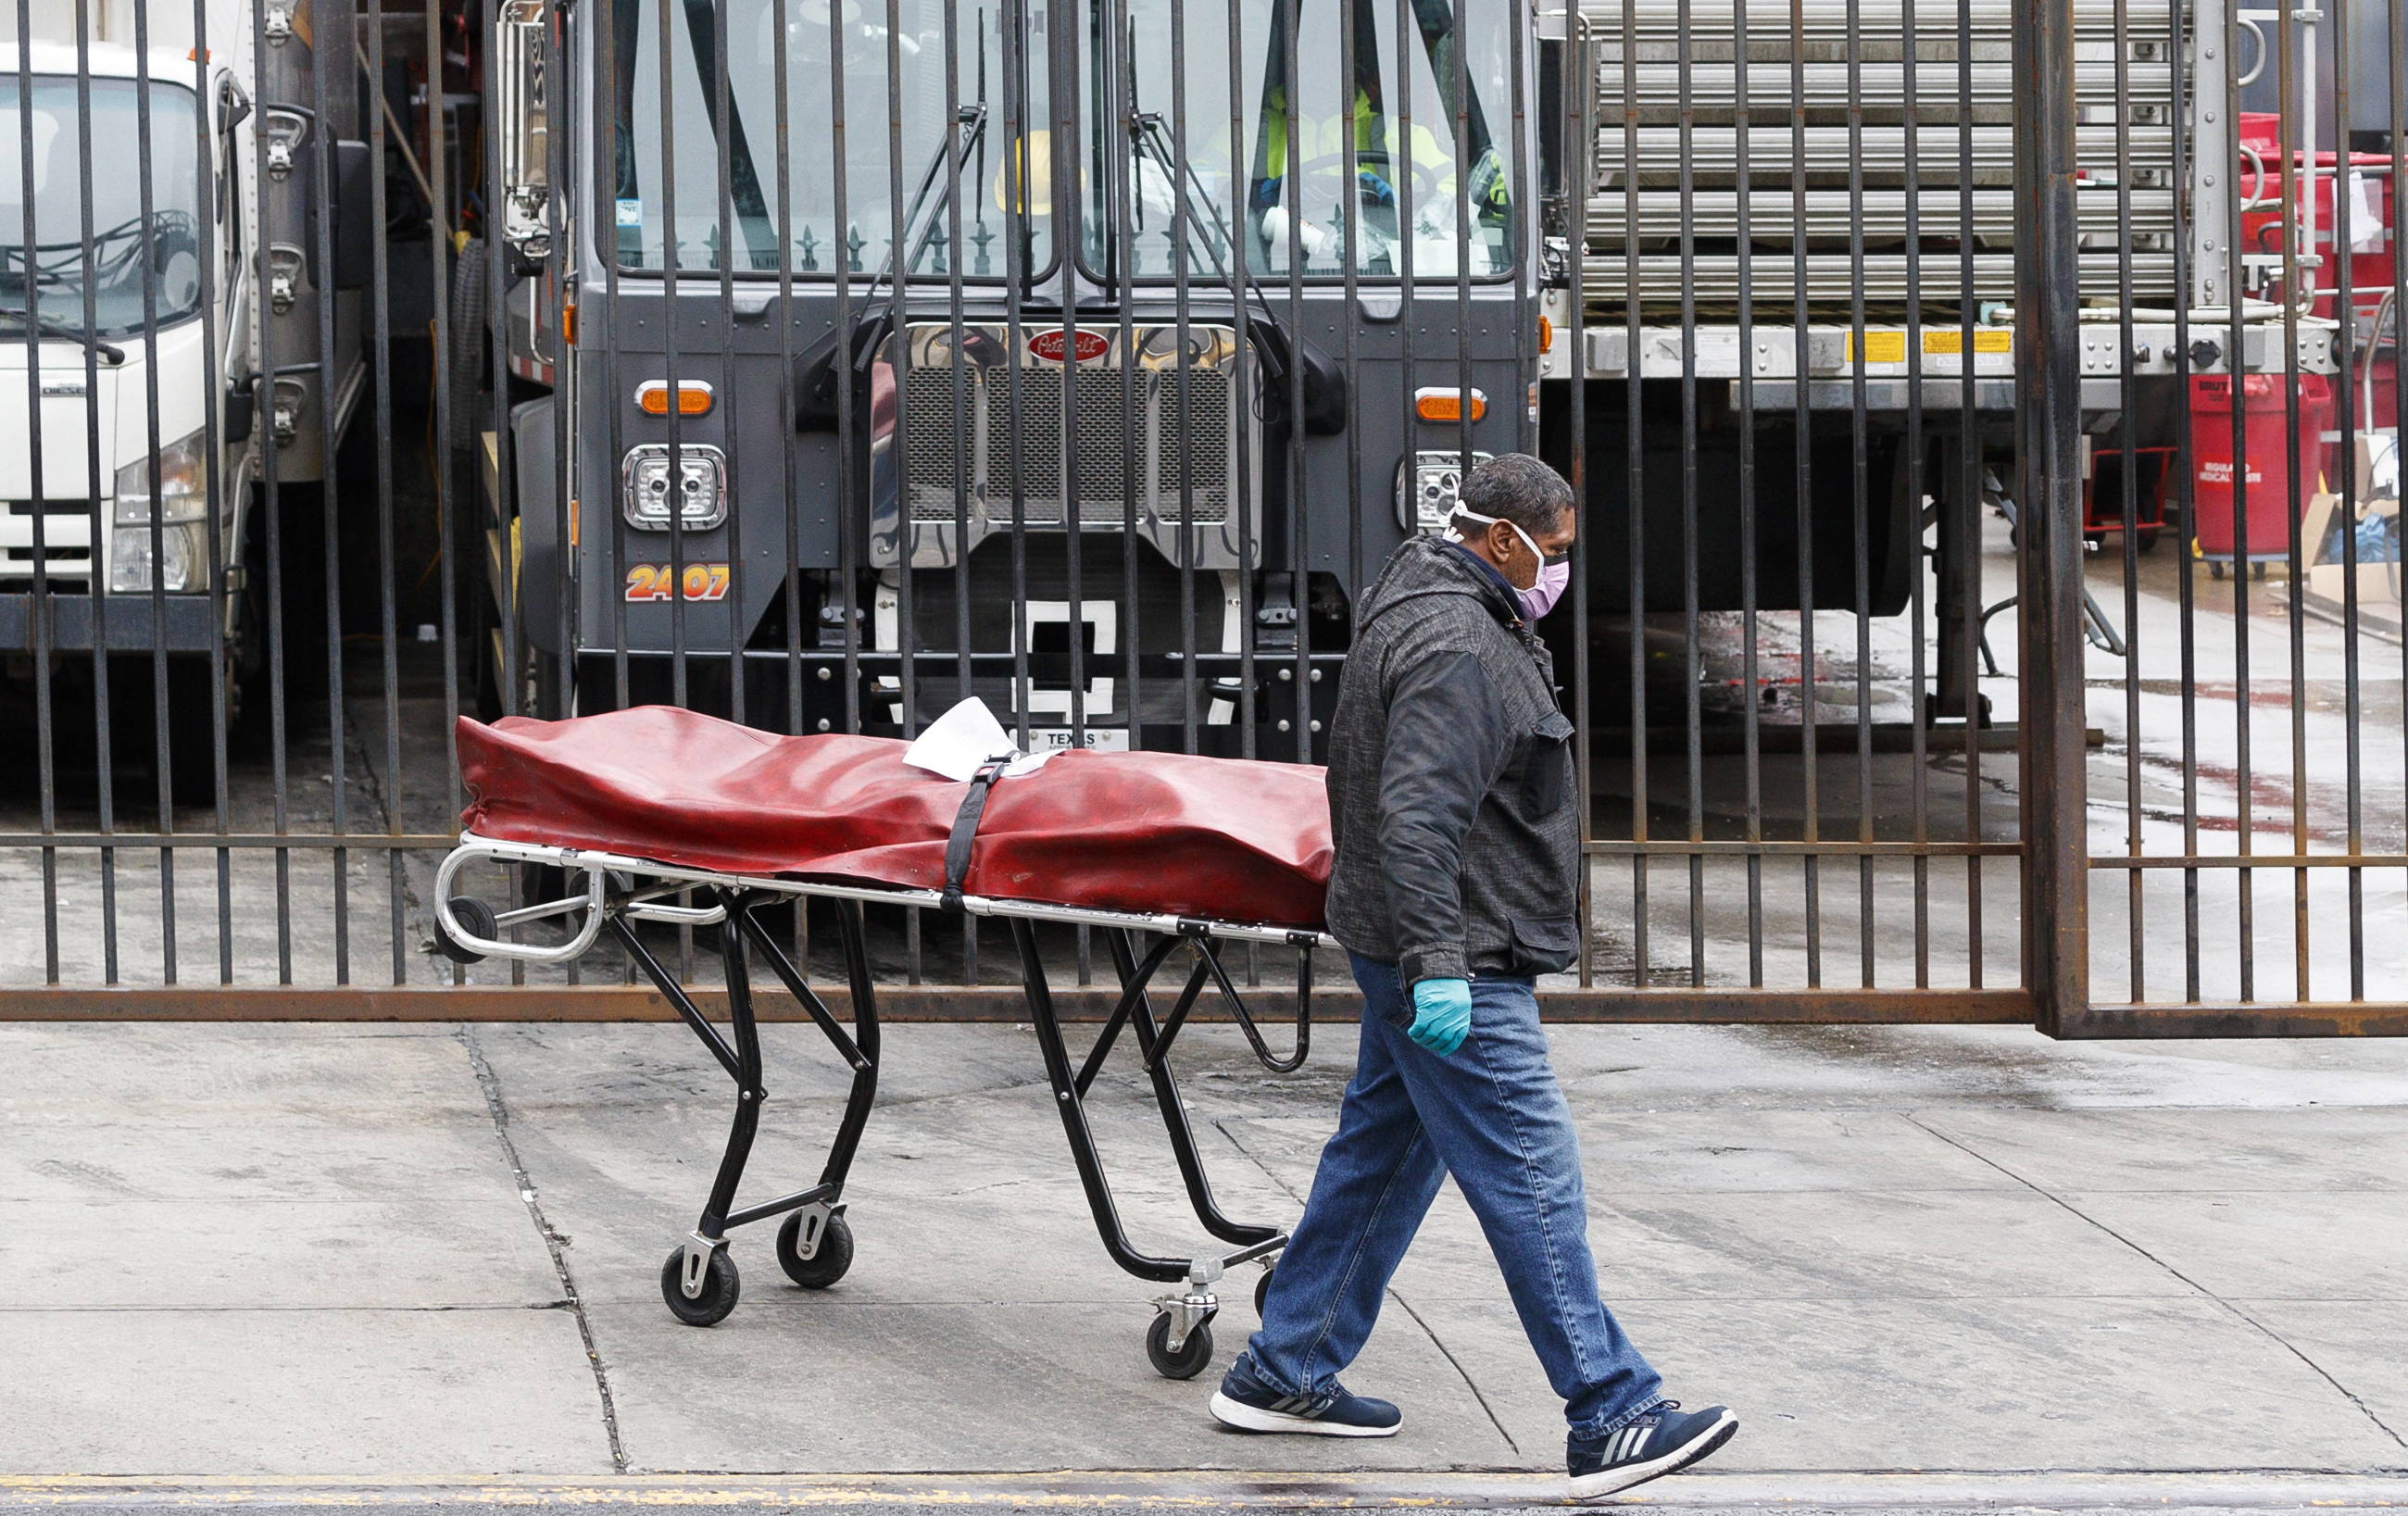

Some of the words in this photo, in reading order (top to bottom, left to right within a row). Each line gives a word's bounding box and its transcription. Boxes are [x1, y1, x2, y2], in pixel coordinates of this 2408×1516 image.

[1037, 335, 1102, 355] Peteilt
[2199, 381, 2228, 392] BRUT
[625, 563, 730, 602] 2407
[1047, 733, 1096, 745] TEXS
